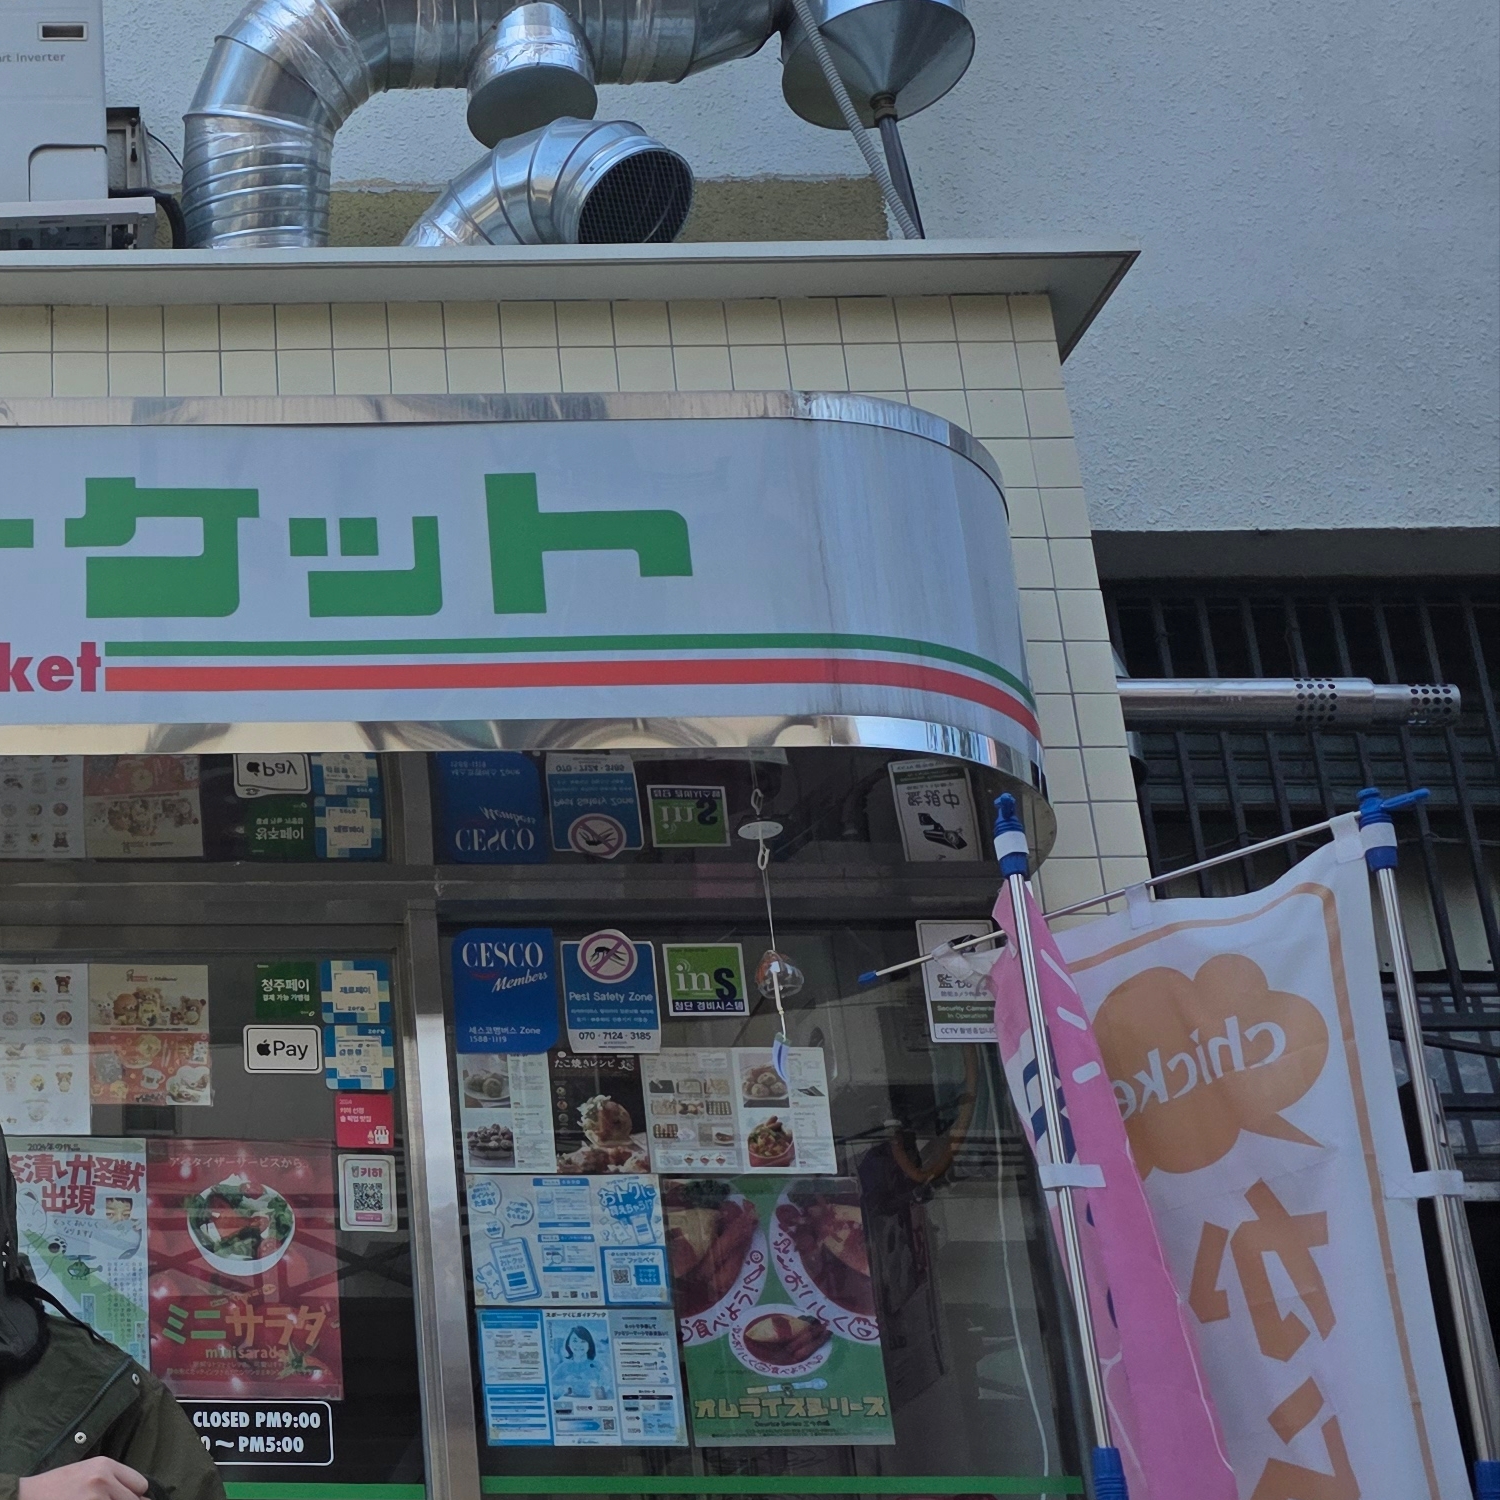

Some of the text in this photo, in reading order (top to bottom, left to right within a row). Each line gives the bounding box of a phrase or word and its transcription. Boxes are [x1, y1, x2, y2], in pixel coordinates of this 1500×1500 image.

[16, 52, 66, 63] Inverter
[462, 941, 544, 969] CESCO
[260, 978, 310, 993] 청주페이
[491, 969, 549, 994] Members
[568, 991, 654, 1004] Pest Safety Zone
[674, 1000, 745, 1012] 첨단 경비시스템
[519, 1026, 541, 1036] Zone
[578, 1031, 652, 1041] 070 7124 3185
[940, 1027, 958, 1035] CCTV
[273, 1040, 309, 1061] Pay
[26, 1142, 81, 1152] 2024年の作品
[41, 1182, 97, 1216] 出現
[598, 1182, 658, 1207] おトクに
[161, 1302, 333, 1349] ミニサラダ
[192, 1411, 322, 1429] CLOSED PM9:00
[237, 1436, 305, 1453] PM5:00
